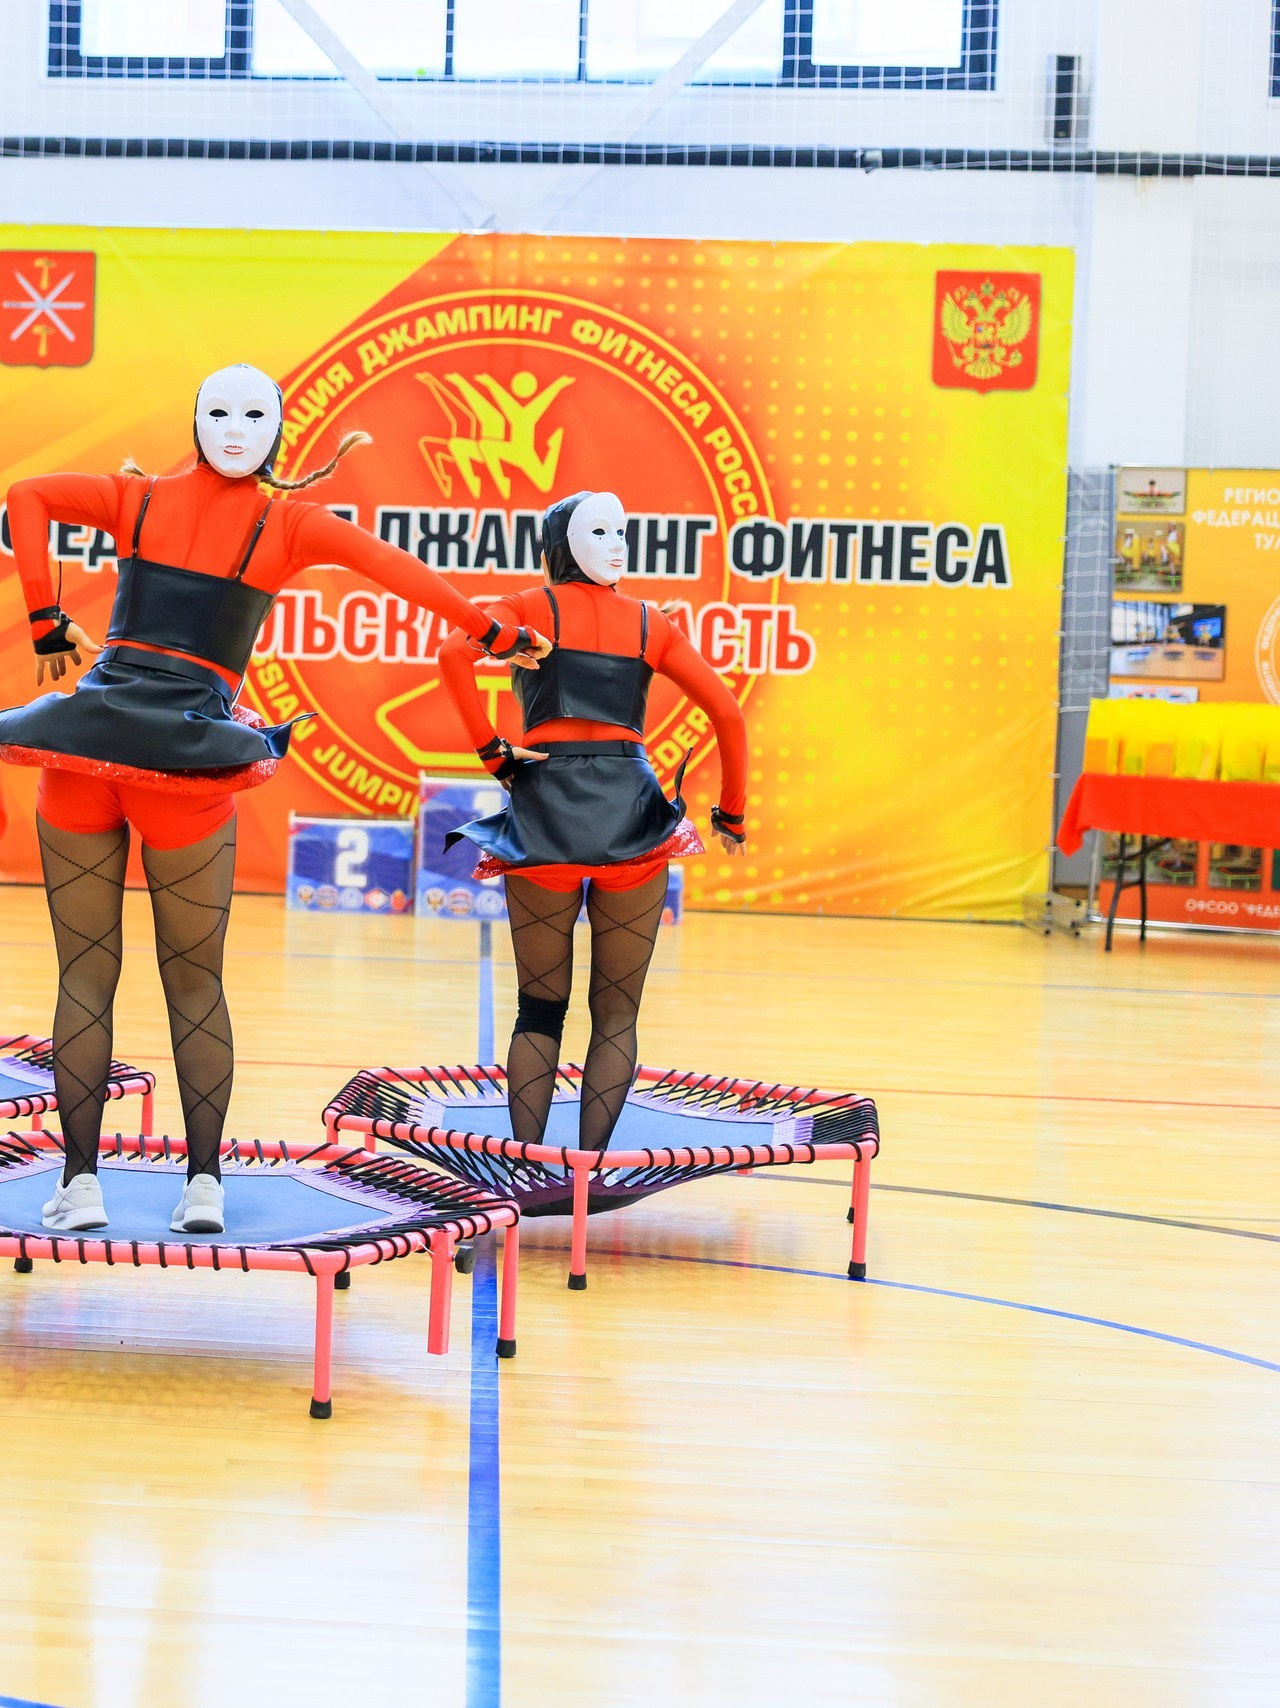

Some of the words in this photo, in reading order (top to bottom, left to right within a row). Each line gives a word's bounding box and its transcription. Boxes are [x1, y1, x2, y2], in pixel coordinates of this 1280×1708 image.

[357, 303, 563, 376] ДЖАМПИНГ
[571, 318, 712, 429] ФИТНЕСА
[703, 425, 759, 521] РОСС
[379, 510, 712, 576] ДЖАМИНГ
[730, 520, 1010, 586] ФИТНЕСА
[312, 743, 420, 818] JUMPI
[335, 828, 369, 887] 2
